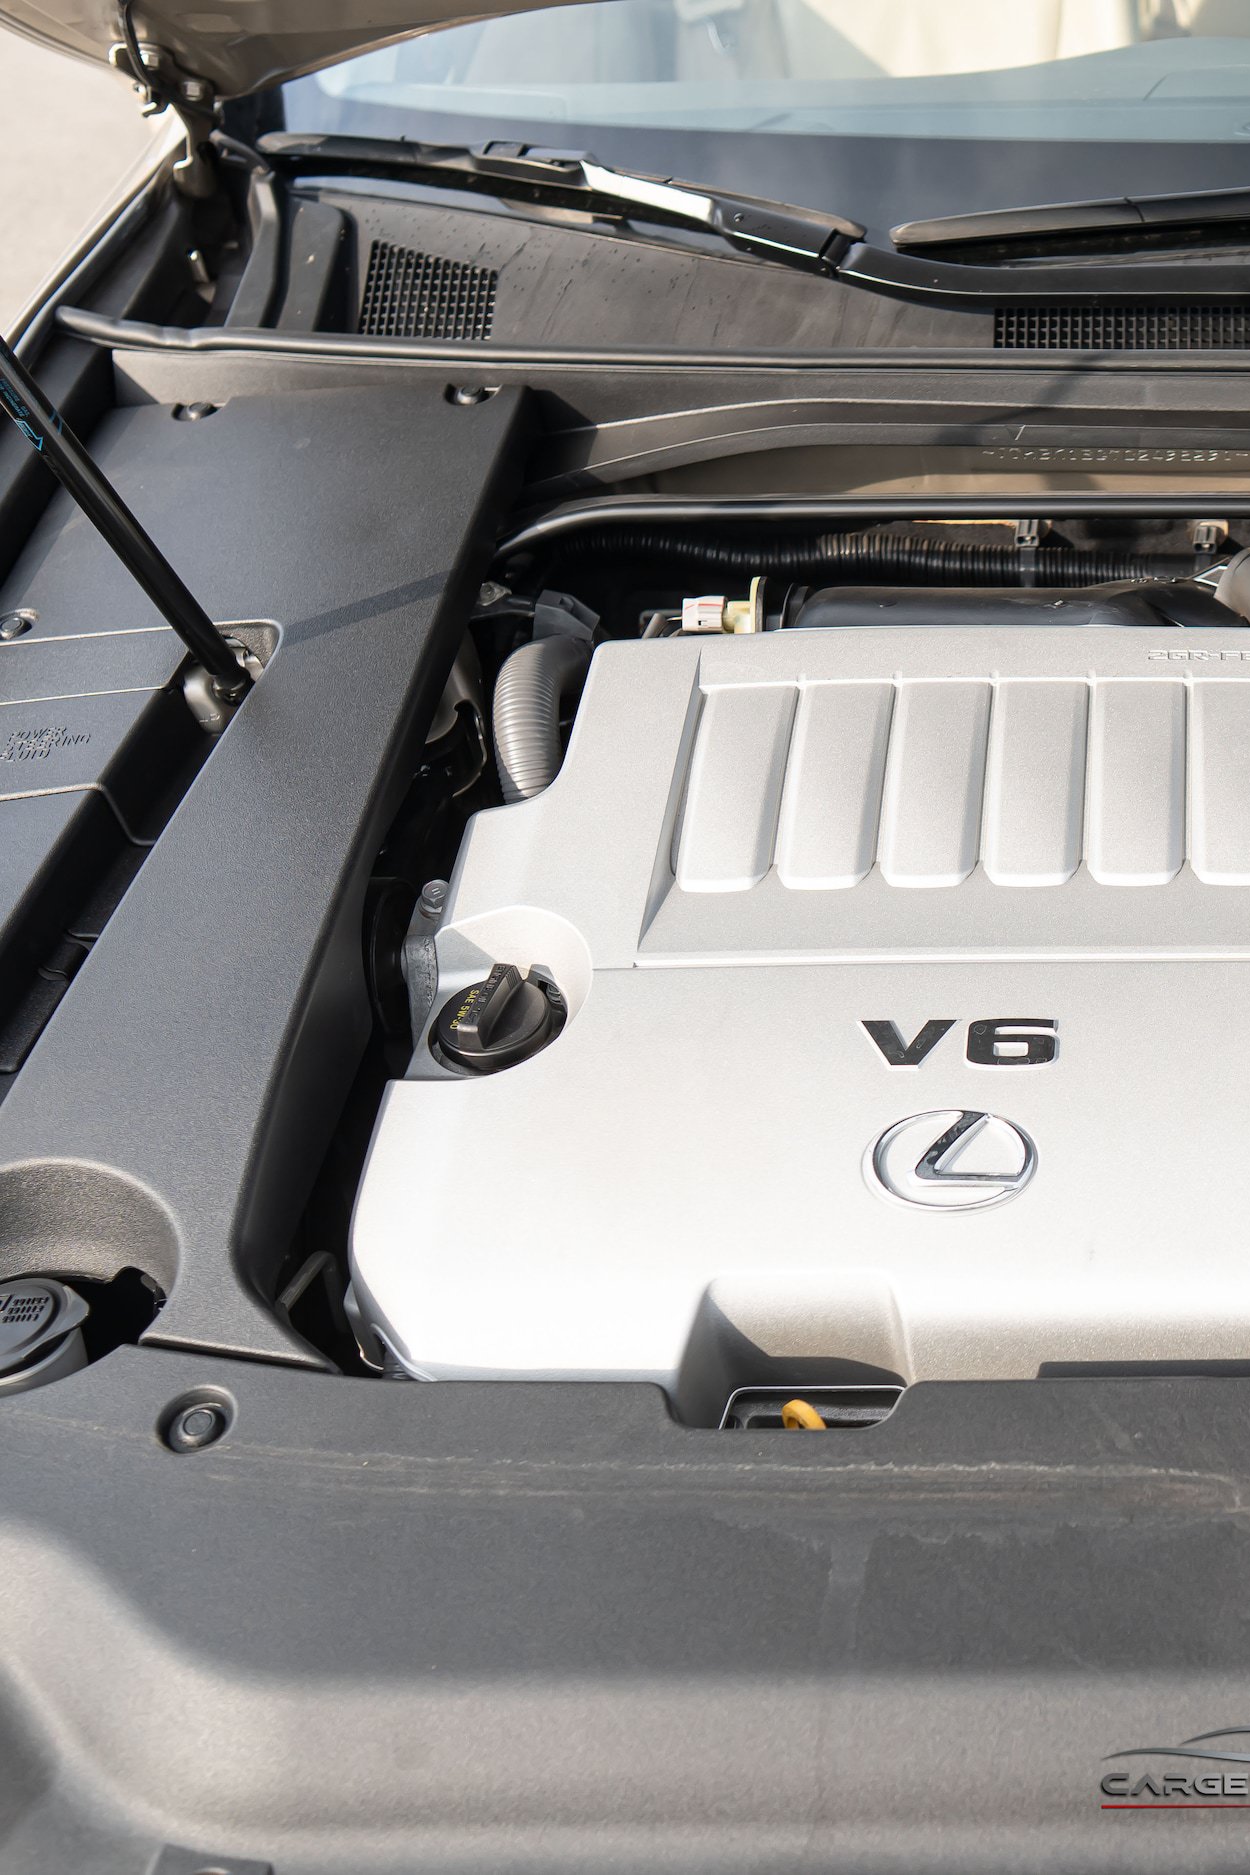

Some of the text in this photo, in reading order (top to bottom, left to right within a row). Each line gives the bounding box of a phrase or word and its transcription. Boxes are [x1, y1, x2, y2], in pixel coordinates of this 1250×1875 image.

[4, 733, 92, 756] STEERING
[8, 726, 68, 744] POWER
[464, 989, 480, 1005] SAE
[857, 1018, 1060, 1071] V6
